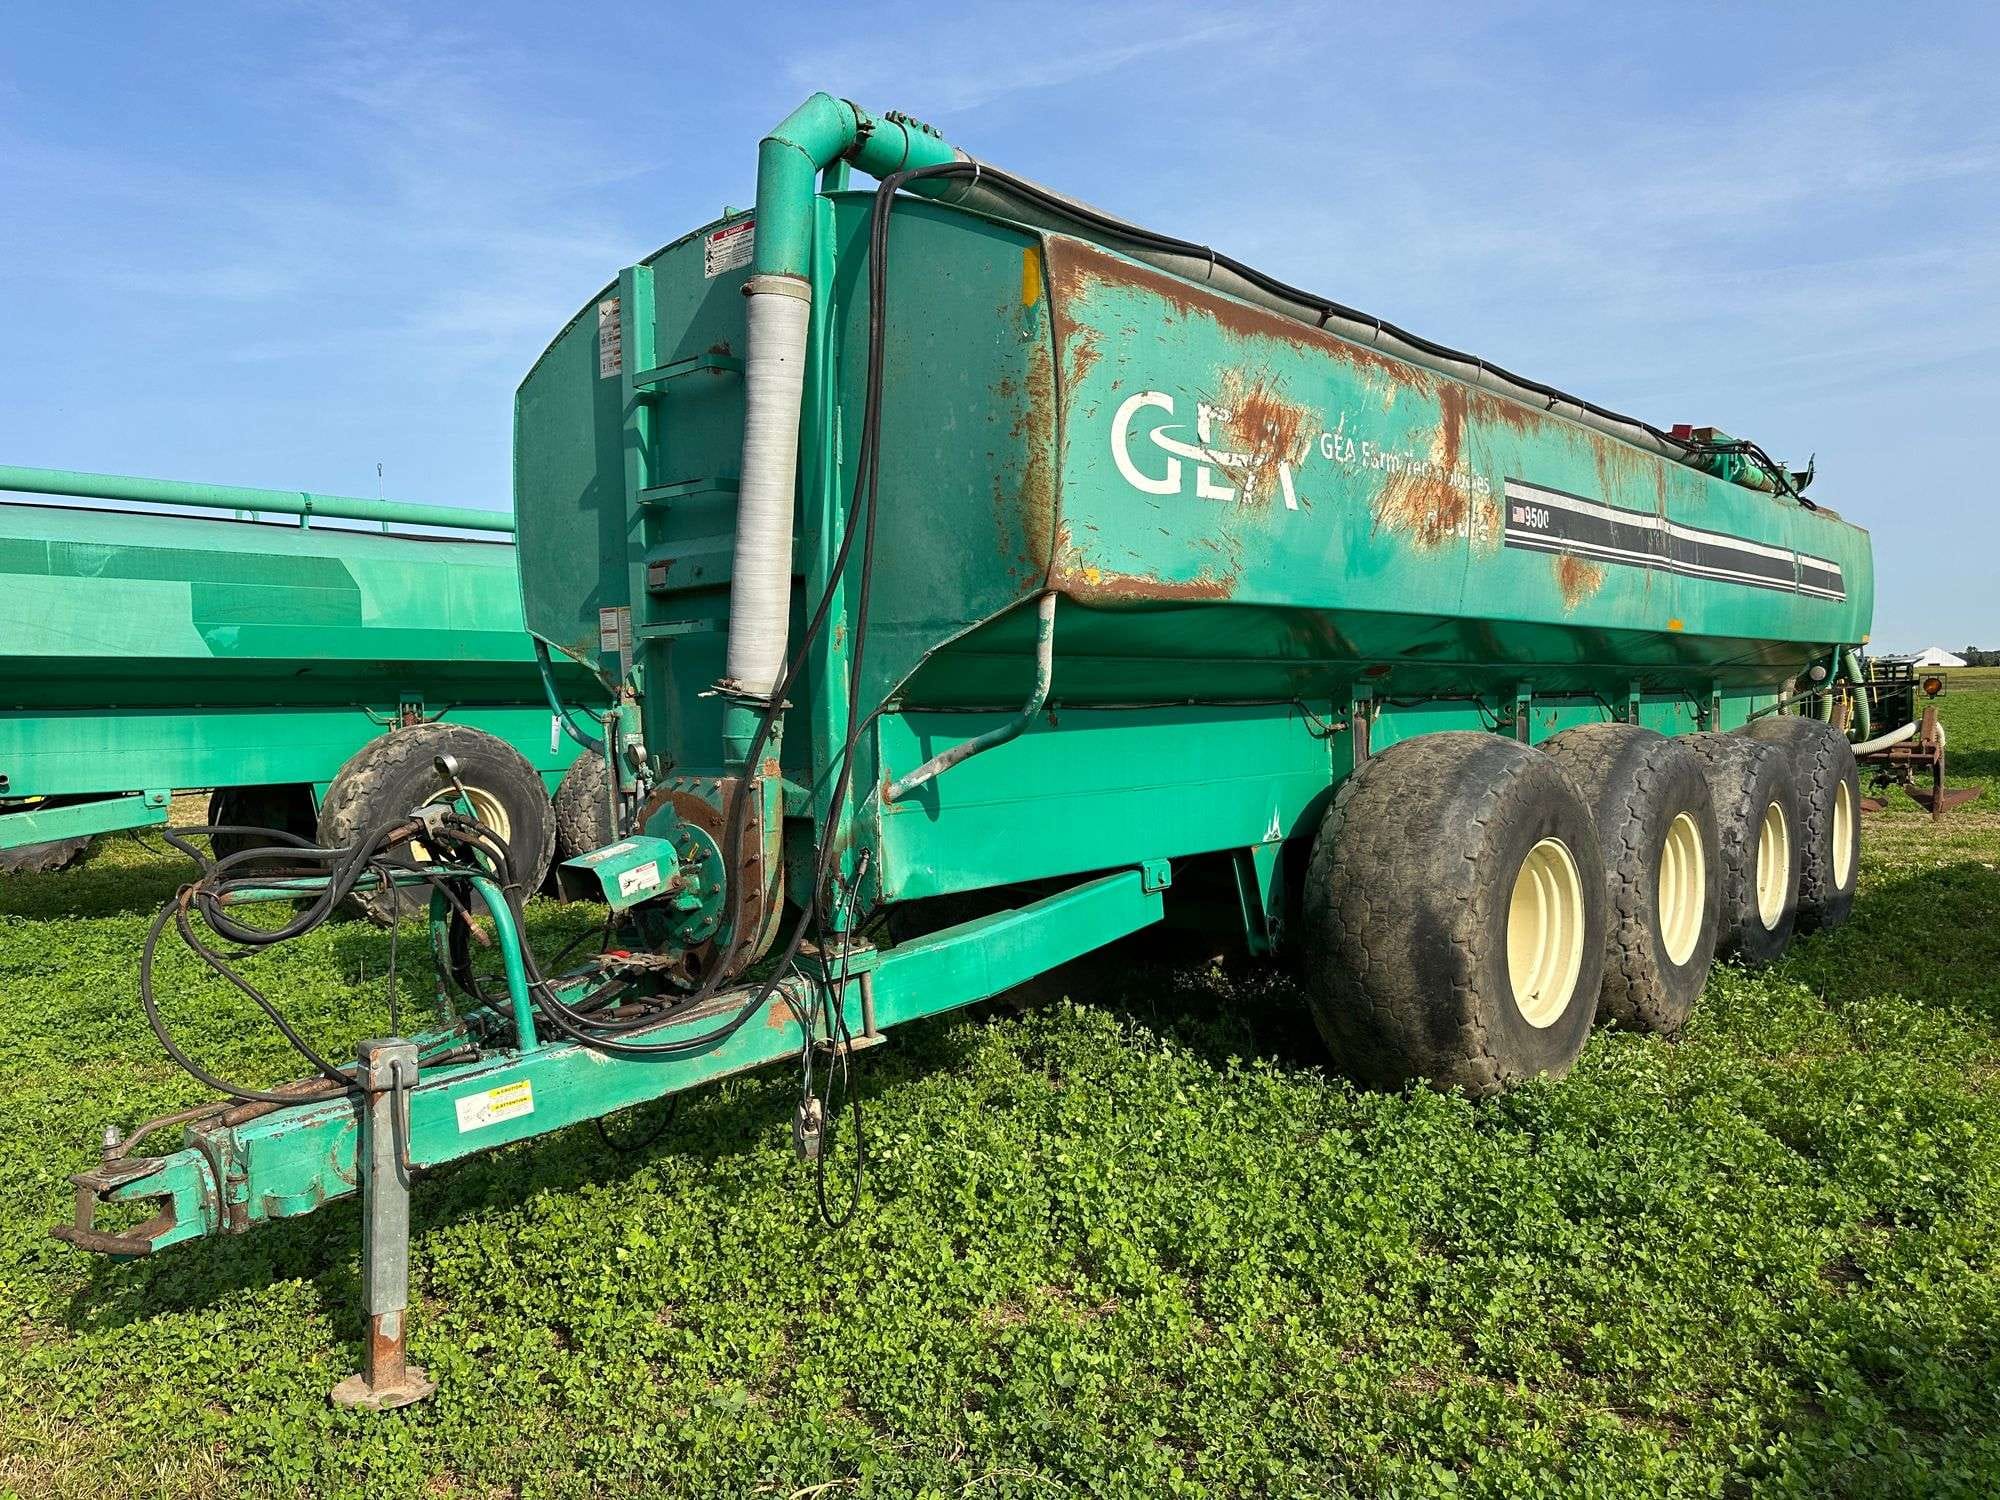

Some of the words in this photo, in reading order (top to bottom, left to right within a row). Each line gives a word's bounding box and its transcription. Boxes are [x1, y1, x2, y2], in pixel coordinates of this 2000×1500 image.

[1111, 391, 1300, 511] GEA
[1320, 432, 1356, 463] GEA
[1362, 441, 1402, 474] Farm
[1404, 450, 1491, 495] Teclogies
[1525, 505, 1549, 529] 9500
